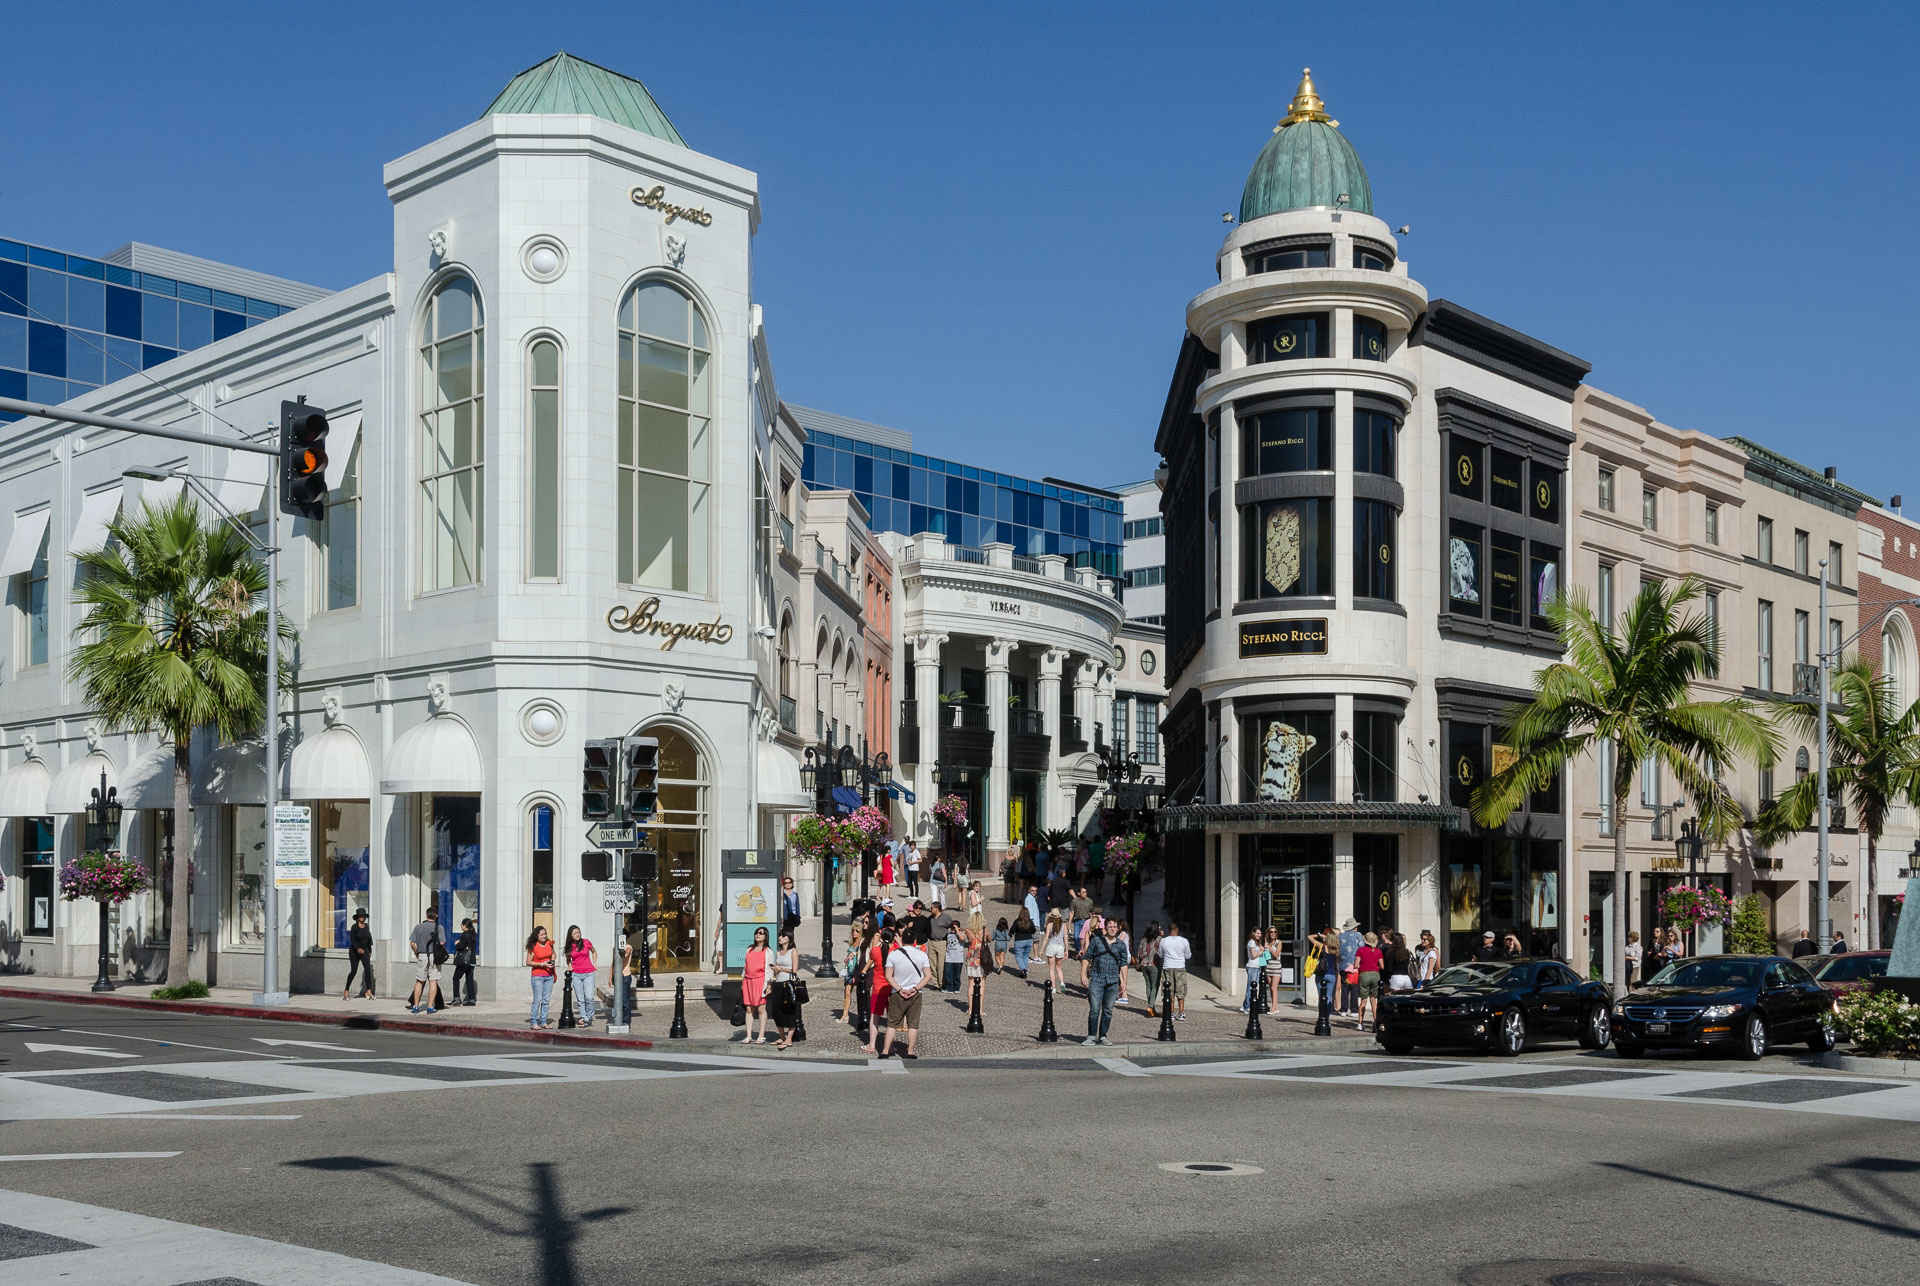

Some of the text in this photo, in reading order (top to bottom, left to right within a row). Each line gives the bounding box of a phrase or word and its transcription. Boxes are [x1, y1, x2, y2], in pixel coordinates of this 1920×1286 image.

[629, 185, 712, 227] Breguet
[1261, 439, 1287, 447] STEFANO
[990, 600, 1021, 615] VERSACE
[606, 597, 733, 651] Breguet
[1242, 630, 1323, 645] STEFANO RICCI
[600, 830, 631, 840] ONE WAY
[676, 885, 691, 894] Getty
[604, 900, 616, 909] OK
